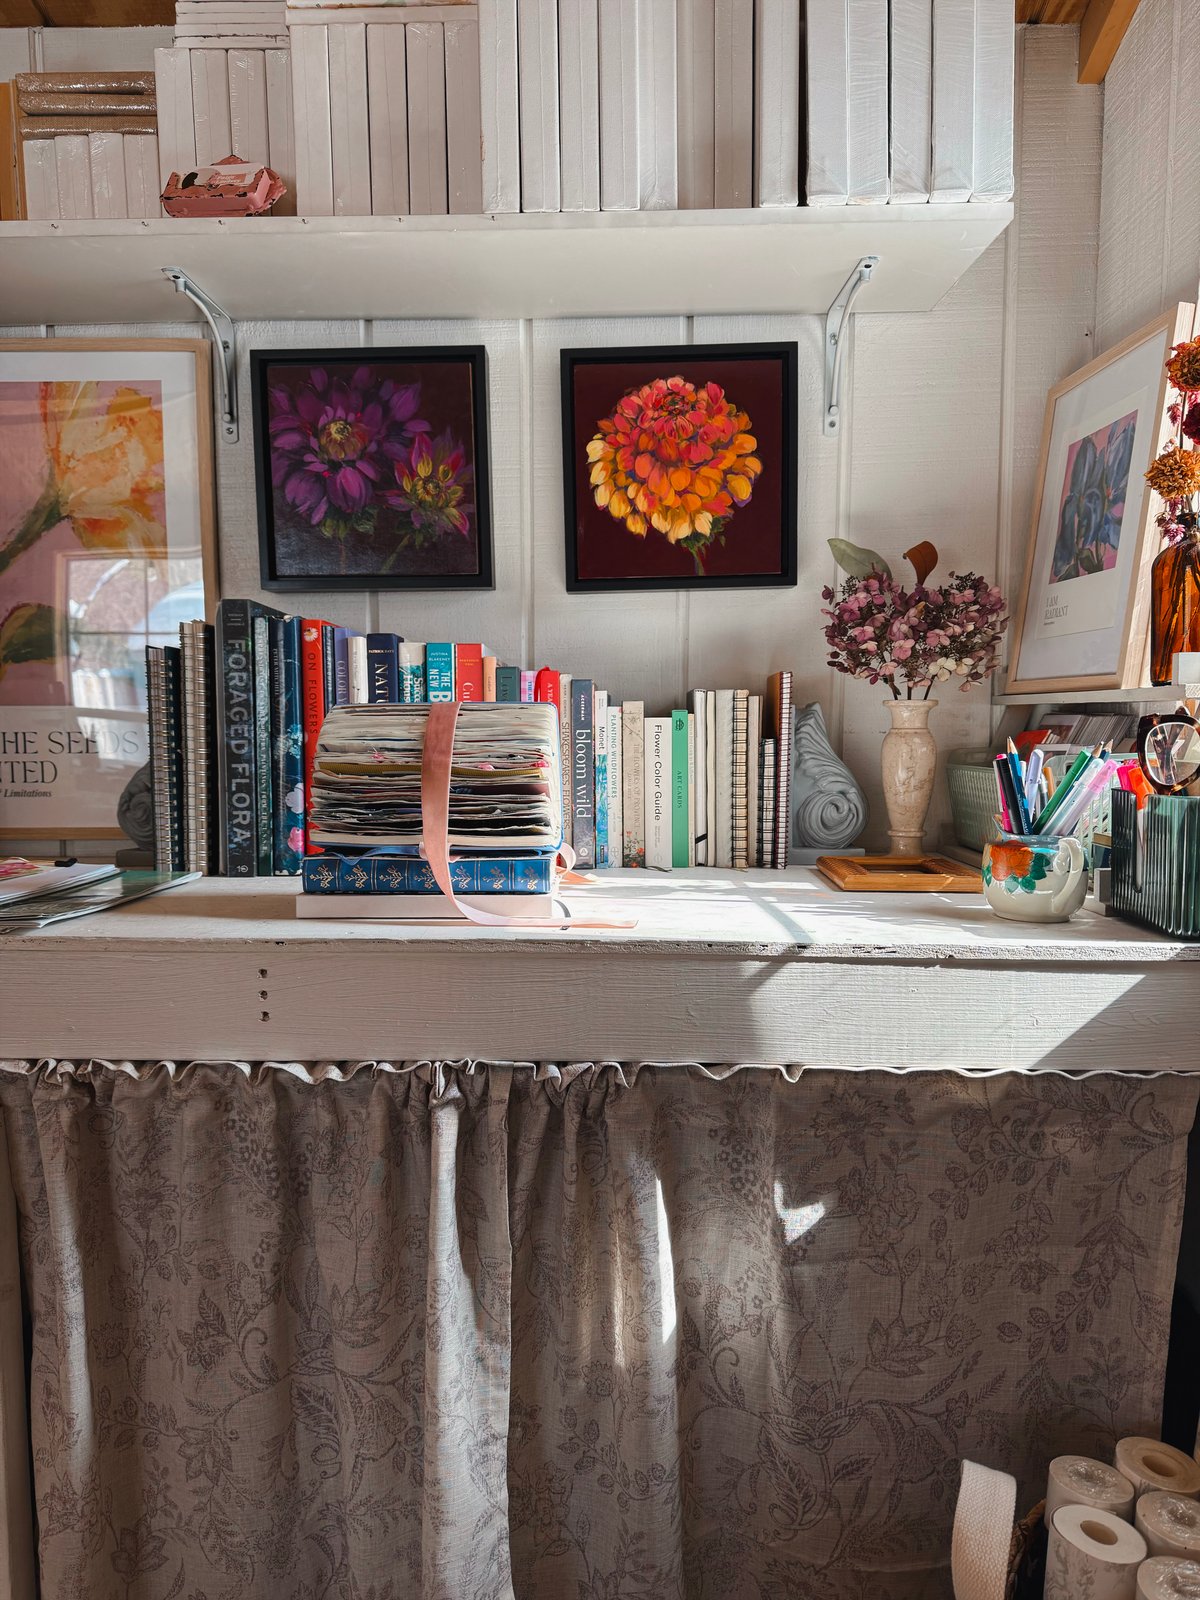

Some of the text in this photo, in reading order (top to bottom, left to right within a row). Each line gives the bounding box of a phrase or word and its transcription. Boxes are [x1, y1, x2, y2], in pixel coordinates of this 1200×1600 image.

[337, 660, 347, 694] COLOR
[430, 669, 439, 688] NEW
[441, 671, 451, 688] THE
[227, 639, 249, 755] FORAGED
[308, 652, 318, 734] ON FLOWERS
[48, 731, 139, 754] SEEDS
[598, 726, 606, 750] Monet
[654, 724, 662, 758] Flower
[0, 760, 58, 783] TED
[576, 729, 592, 818] bloom wild
[610, 751, 618, 799] WILDFLOWERS
[654, 761, 662, 788] Color
[4, 788, 52, 798] Limitations
[231, 762, 251, 843] FLORA
[634, 786, 640, 796] OF
[654, 791, 662, 821] Guide
[562, 790, 571, 830] FLOWERS
